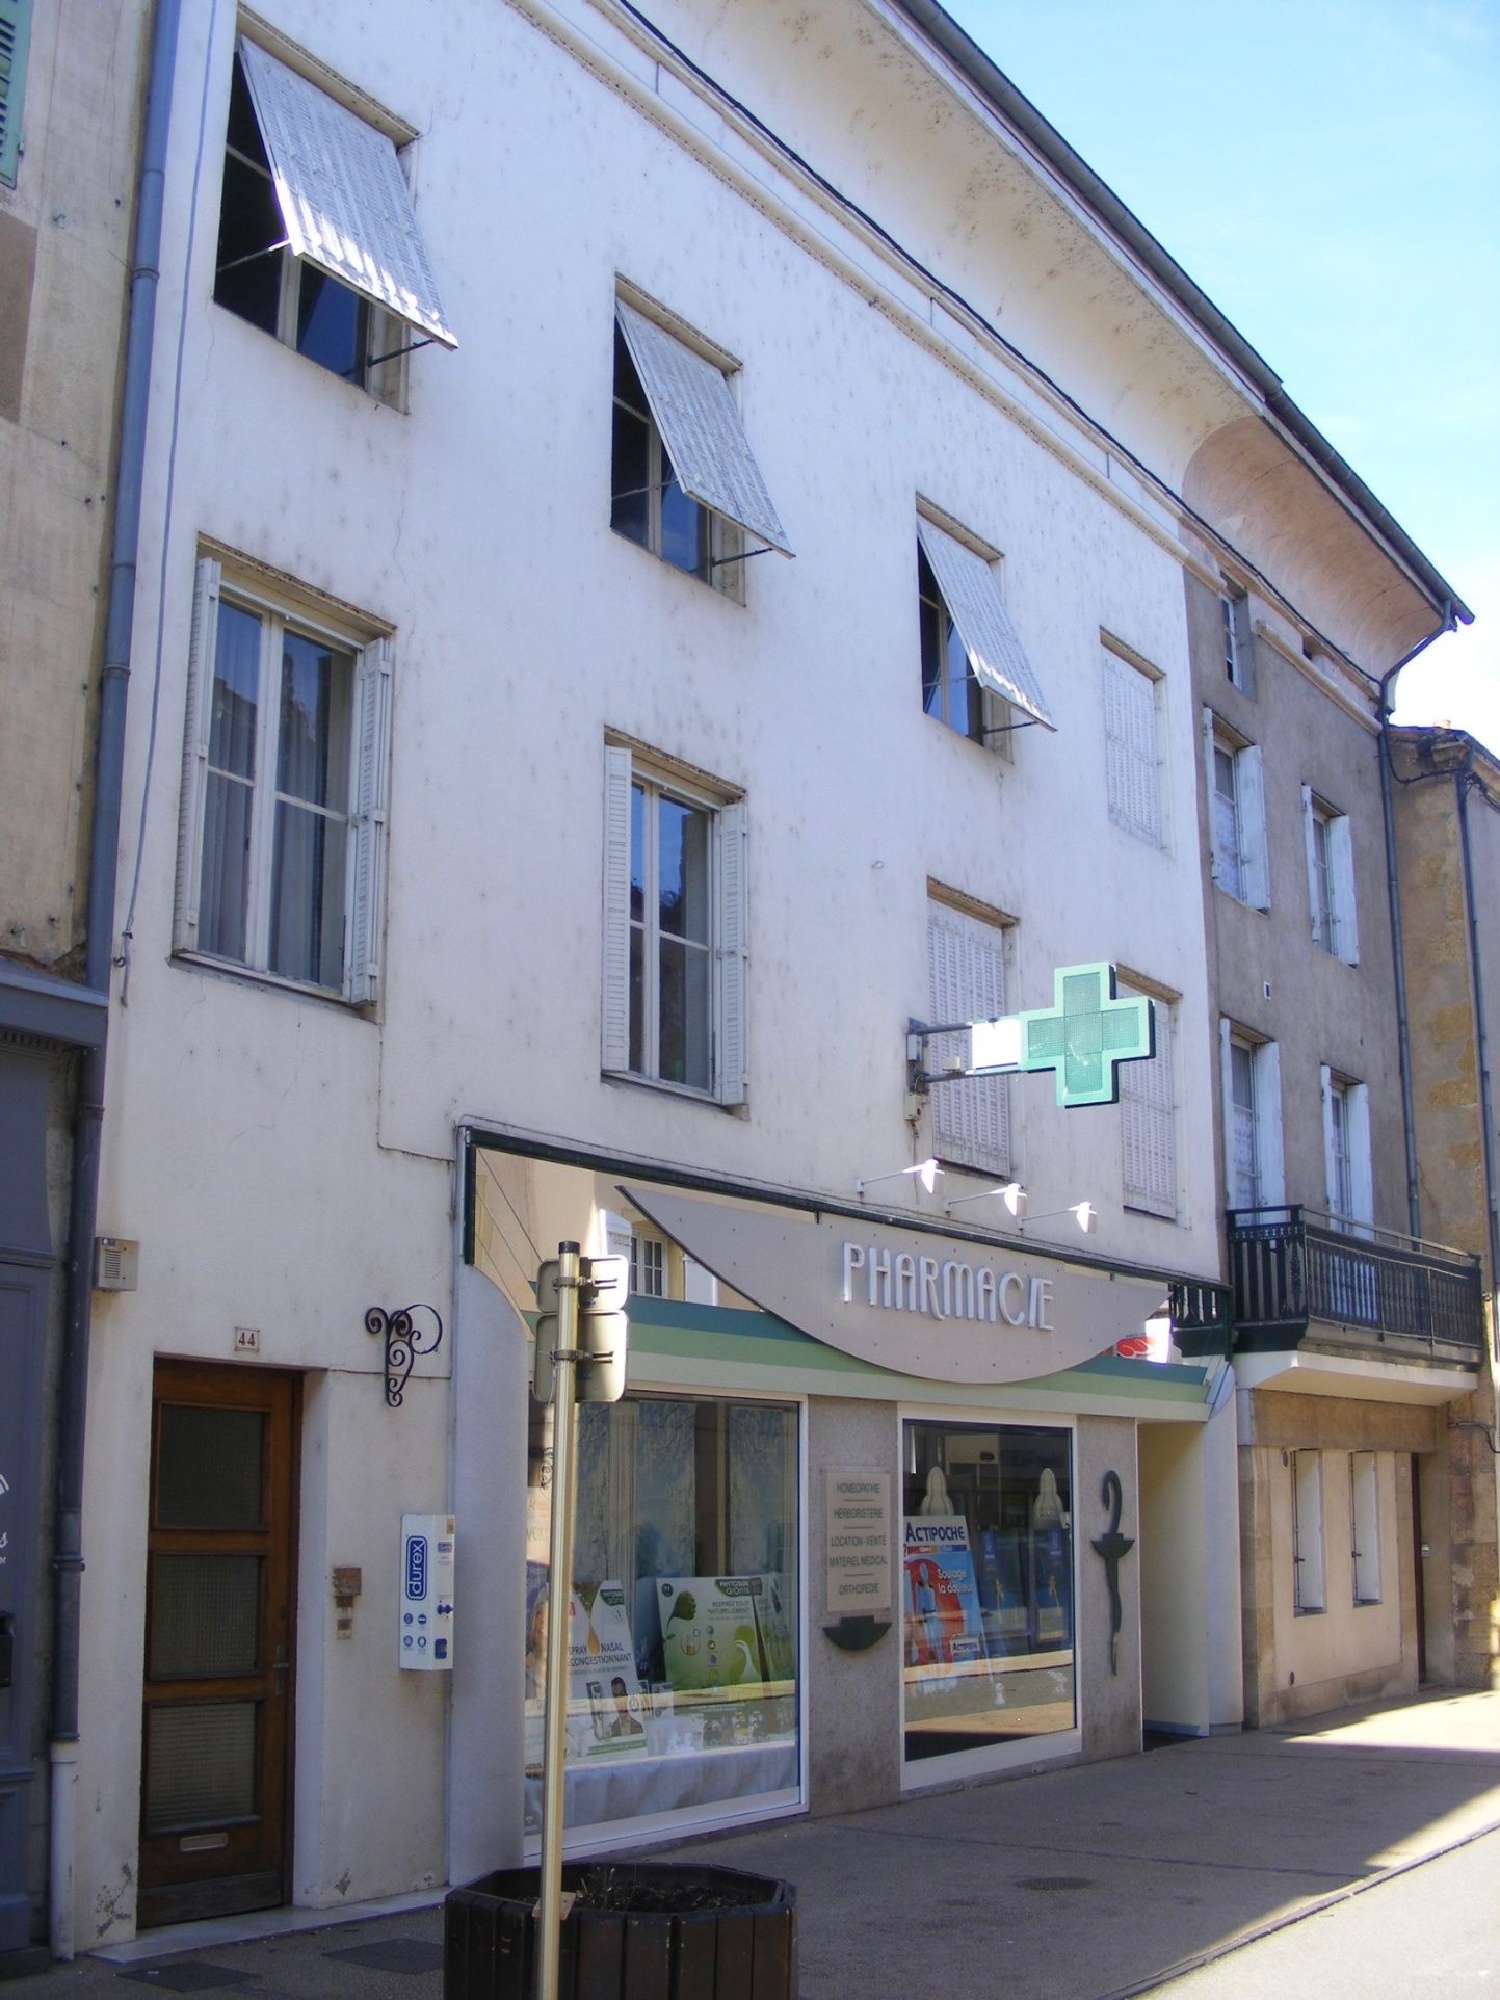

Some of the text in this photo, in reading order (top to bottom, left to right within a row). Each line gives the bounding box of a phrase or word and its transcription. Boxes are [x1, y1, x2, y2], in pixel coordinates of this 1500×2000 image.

[842, 1242, 1054, 1331] PHARMACIE
[238, 1331, 256, 1346] 44
[409, 1541, 426, 1595] durex
[568, 1652, 632, 1667] CONGESTIONNANT
